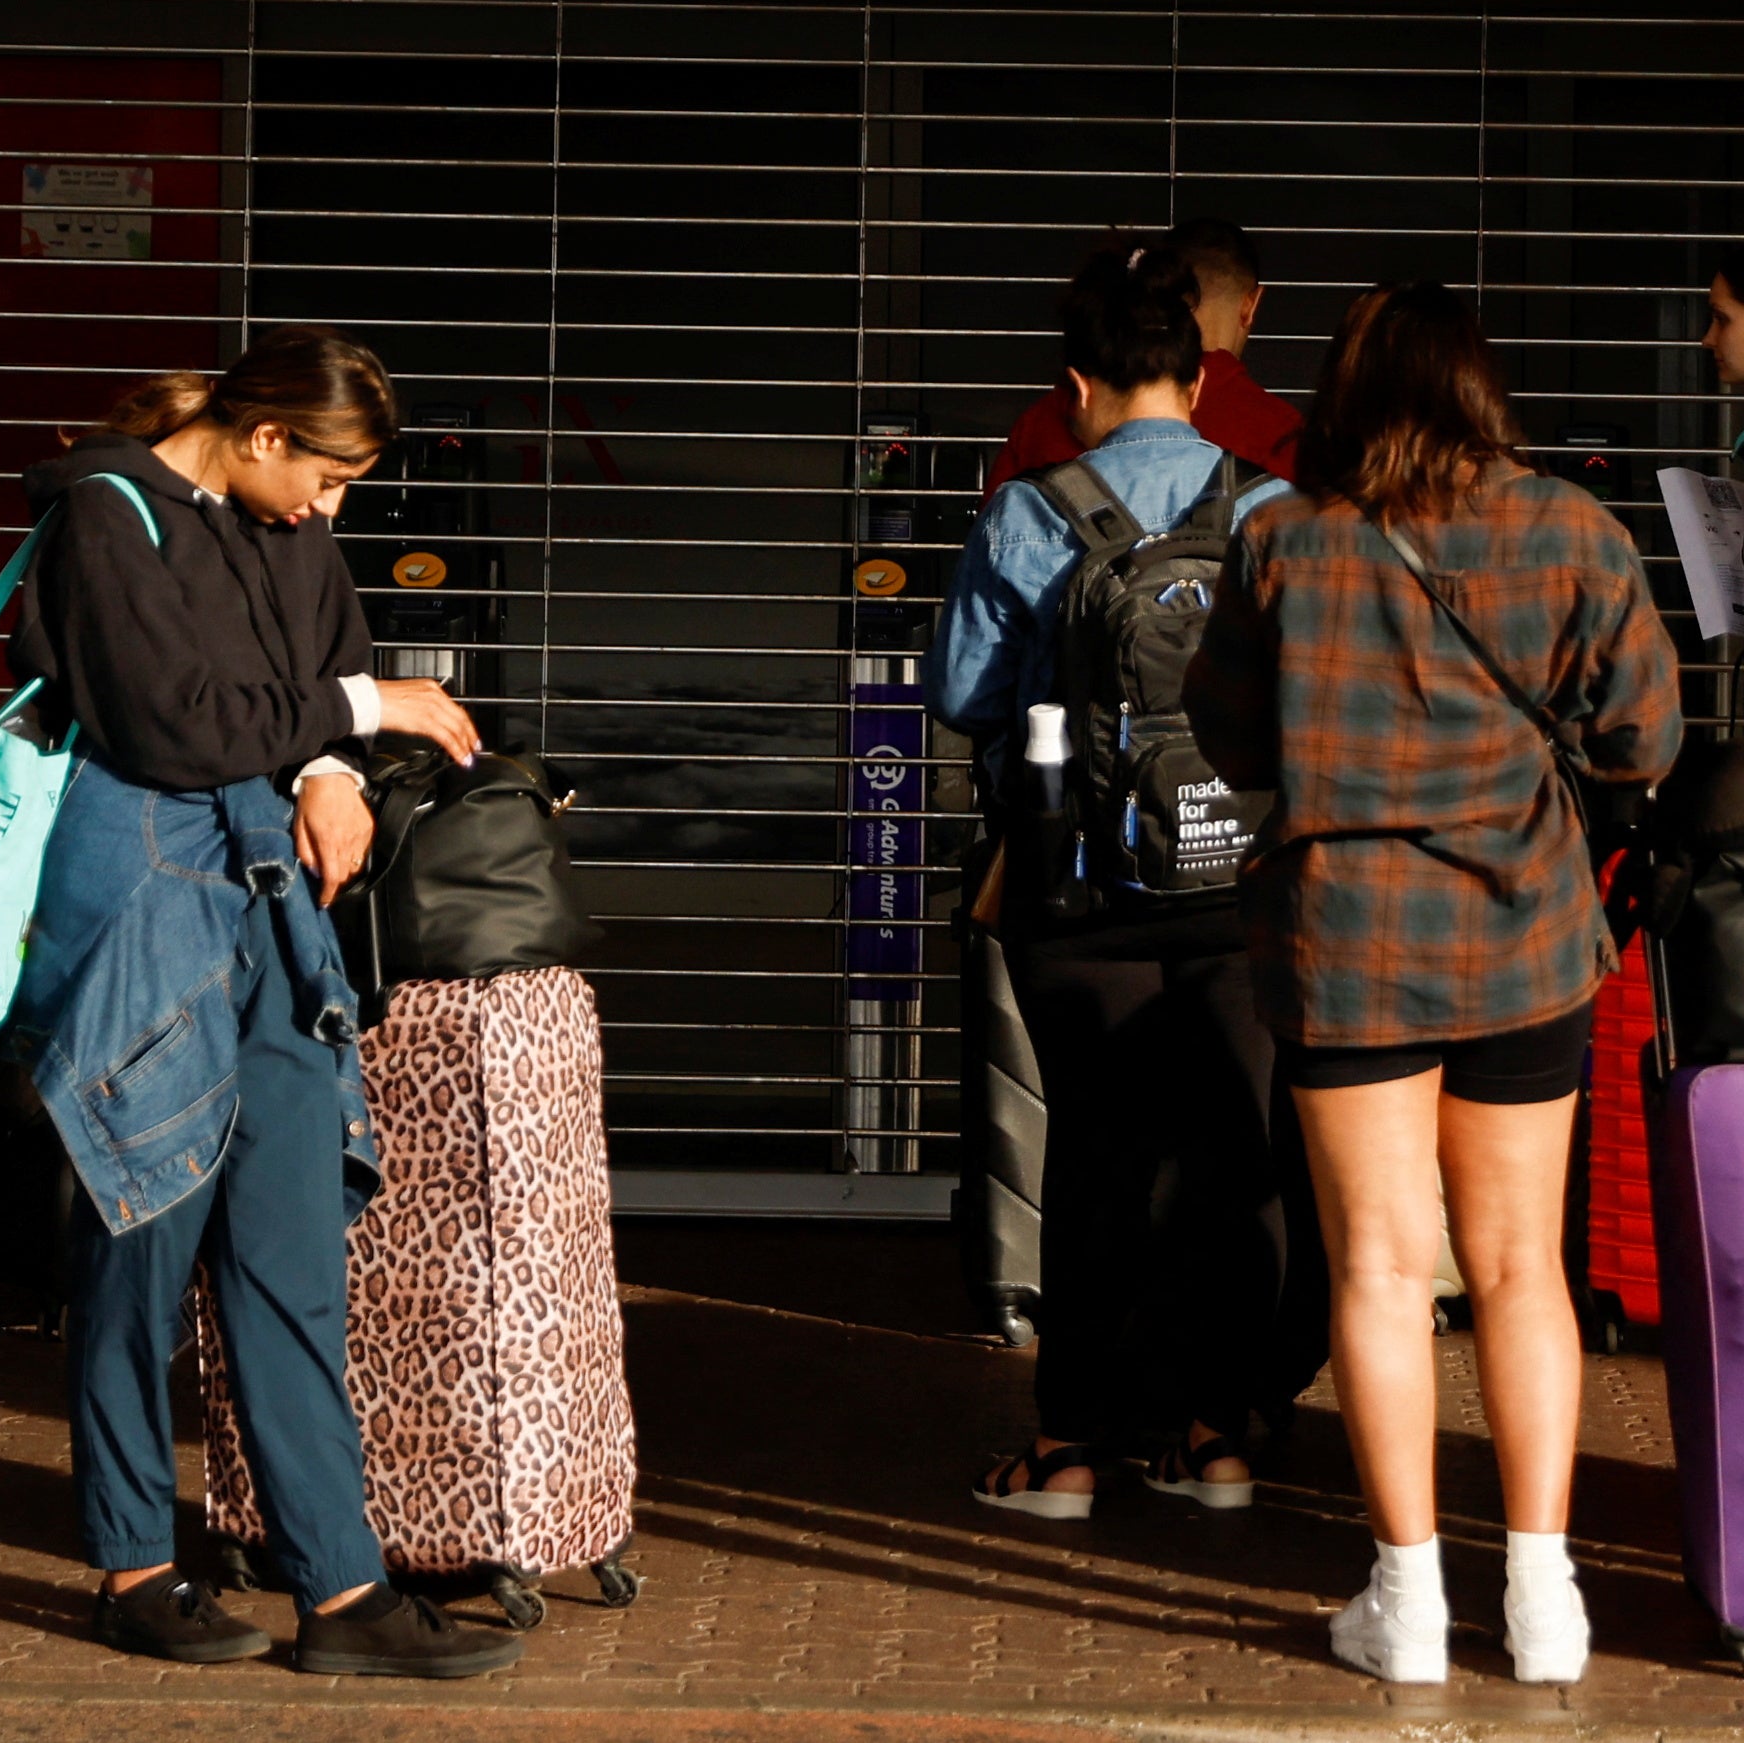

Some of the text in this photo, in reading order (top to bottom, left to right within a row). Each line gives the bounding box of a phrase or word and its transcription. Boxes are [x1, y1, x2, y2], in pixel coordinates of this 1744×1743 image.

[1177, 800, 1209, 822] for
[1176, 833, 1255, 851] GENERAL MOT
[1178, 818, 1238, 843] more
[879, 818, 900, 940] Advnturs
